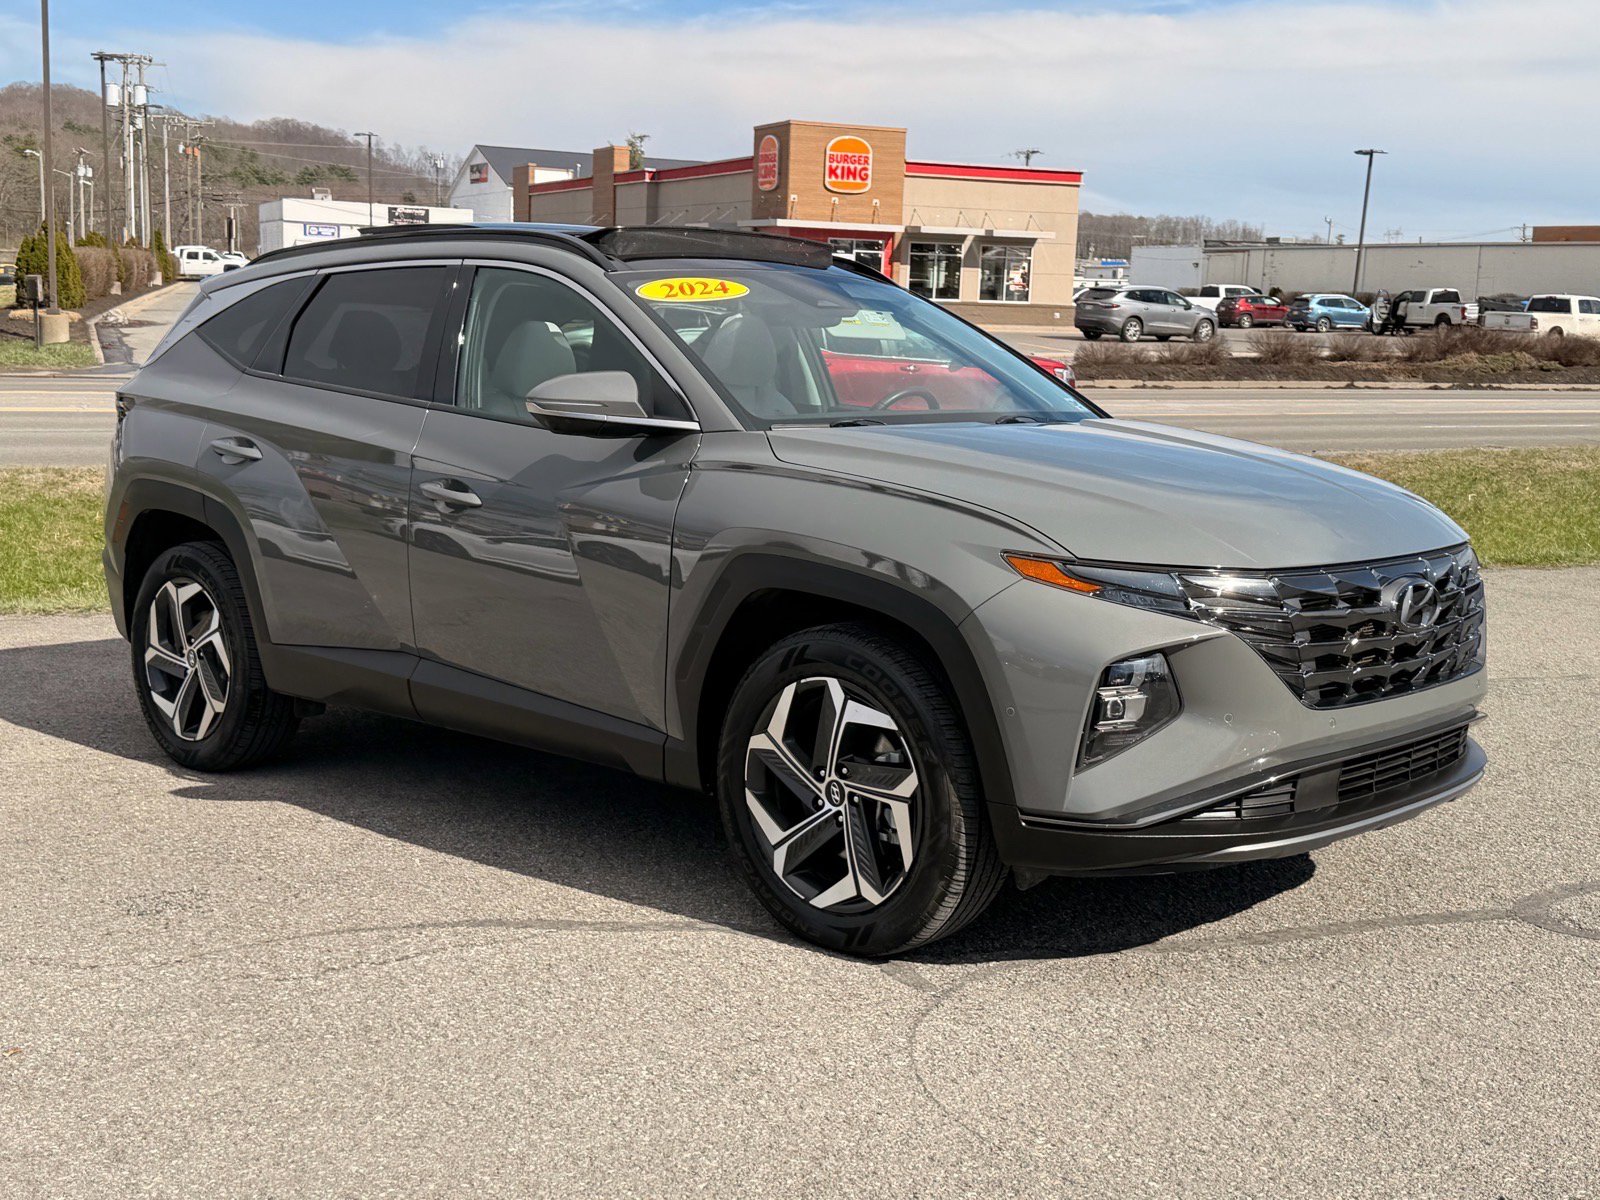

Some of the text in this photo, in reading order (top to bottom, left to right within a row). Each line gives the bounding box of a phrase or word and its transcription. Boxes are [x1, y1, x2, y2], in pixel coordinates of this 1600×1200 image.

[828, 153, 870, 165] BURGER
[828, 165, 869, 181] KING
[660, 281, 730, 298] 2024
